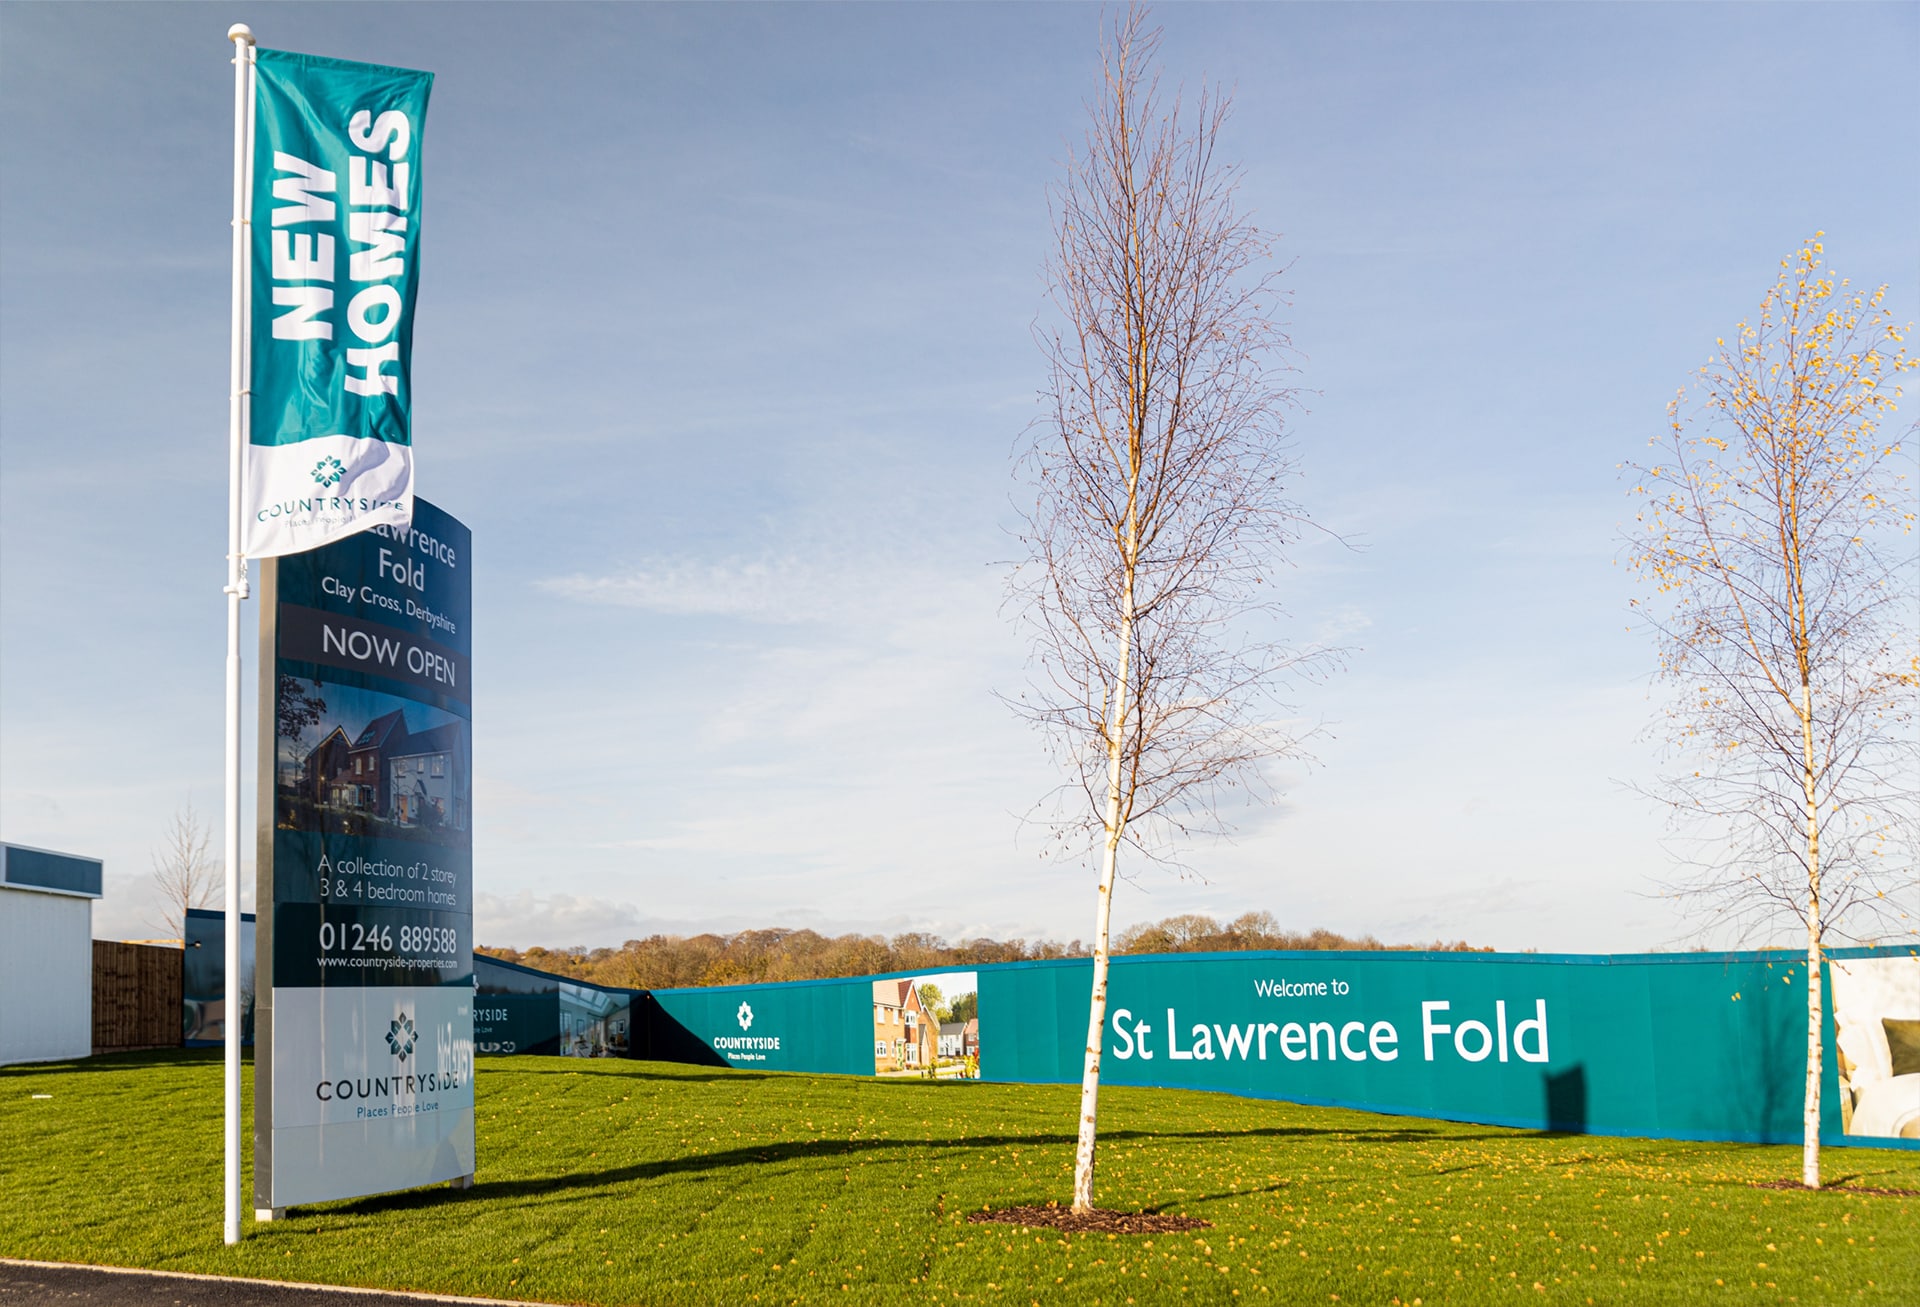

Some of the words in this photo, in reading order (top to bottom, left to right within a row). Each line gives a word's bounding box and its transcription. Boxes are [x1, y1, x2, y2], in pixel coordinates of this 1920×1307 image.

[272, 151, 336, 340] NEW
[344, 110, 410, 396] HOMES
[379, 547, 424, 592] Fold
[321, 576, 355, 603] Clay
[360, 586, 402, 614] Cross,
[406, 599, 456, 634] Derbyshire
[323, 624, 400, 667] NOW
[407, 646, 455, 688] OPEN
[317, 854, 332, 872] A
[337, 857, 403, 877] collection
[407, 862, 420, 879] of
[421, 863, 429, 880] 2
[431, 867, 456, 888] storey
[320, 878, 330, 897] 3
[335, 879, 348, 897] &
[353, 880, 363, 898] 4
[368, 881, 424, 902] bedroom
[428, 886, 456, 905] homes
[319, 922, 393, 951] 01246
[400, 925, 456, 953] 889588
[317, 955, 457, 971] www.countryside-properties.com
[1253, 979, 1327, 998] Welcome
[1330, 978, 1349, 996] to
[713, 1036, 780, 1050] COUNTRYSIDE
[1112, 1008, 1153, 1061] St
[1166, 1008, 1398, 1061] Lawrence
[1422, 999, 1549, 1063] Fold
[316, 1071, 458, 1101] COUNTRYSIDE
[357, 1105, 388, 1118] Places
[391, 1103, 419, 1117] People
[422, 1101, 439, 1112] Love
